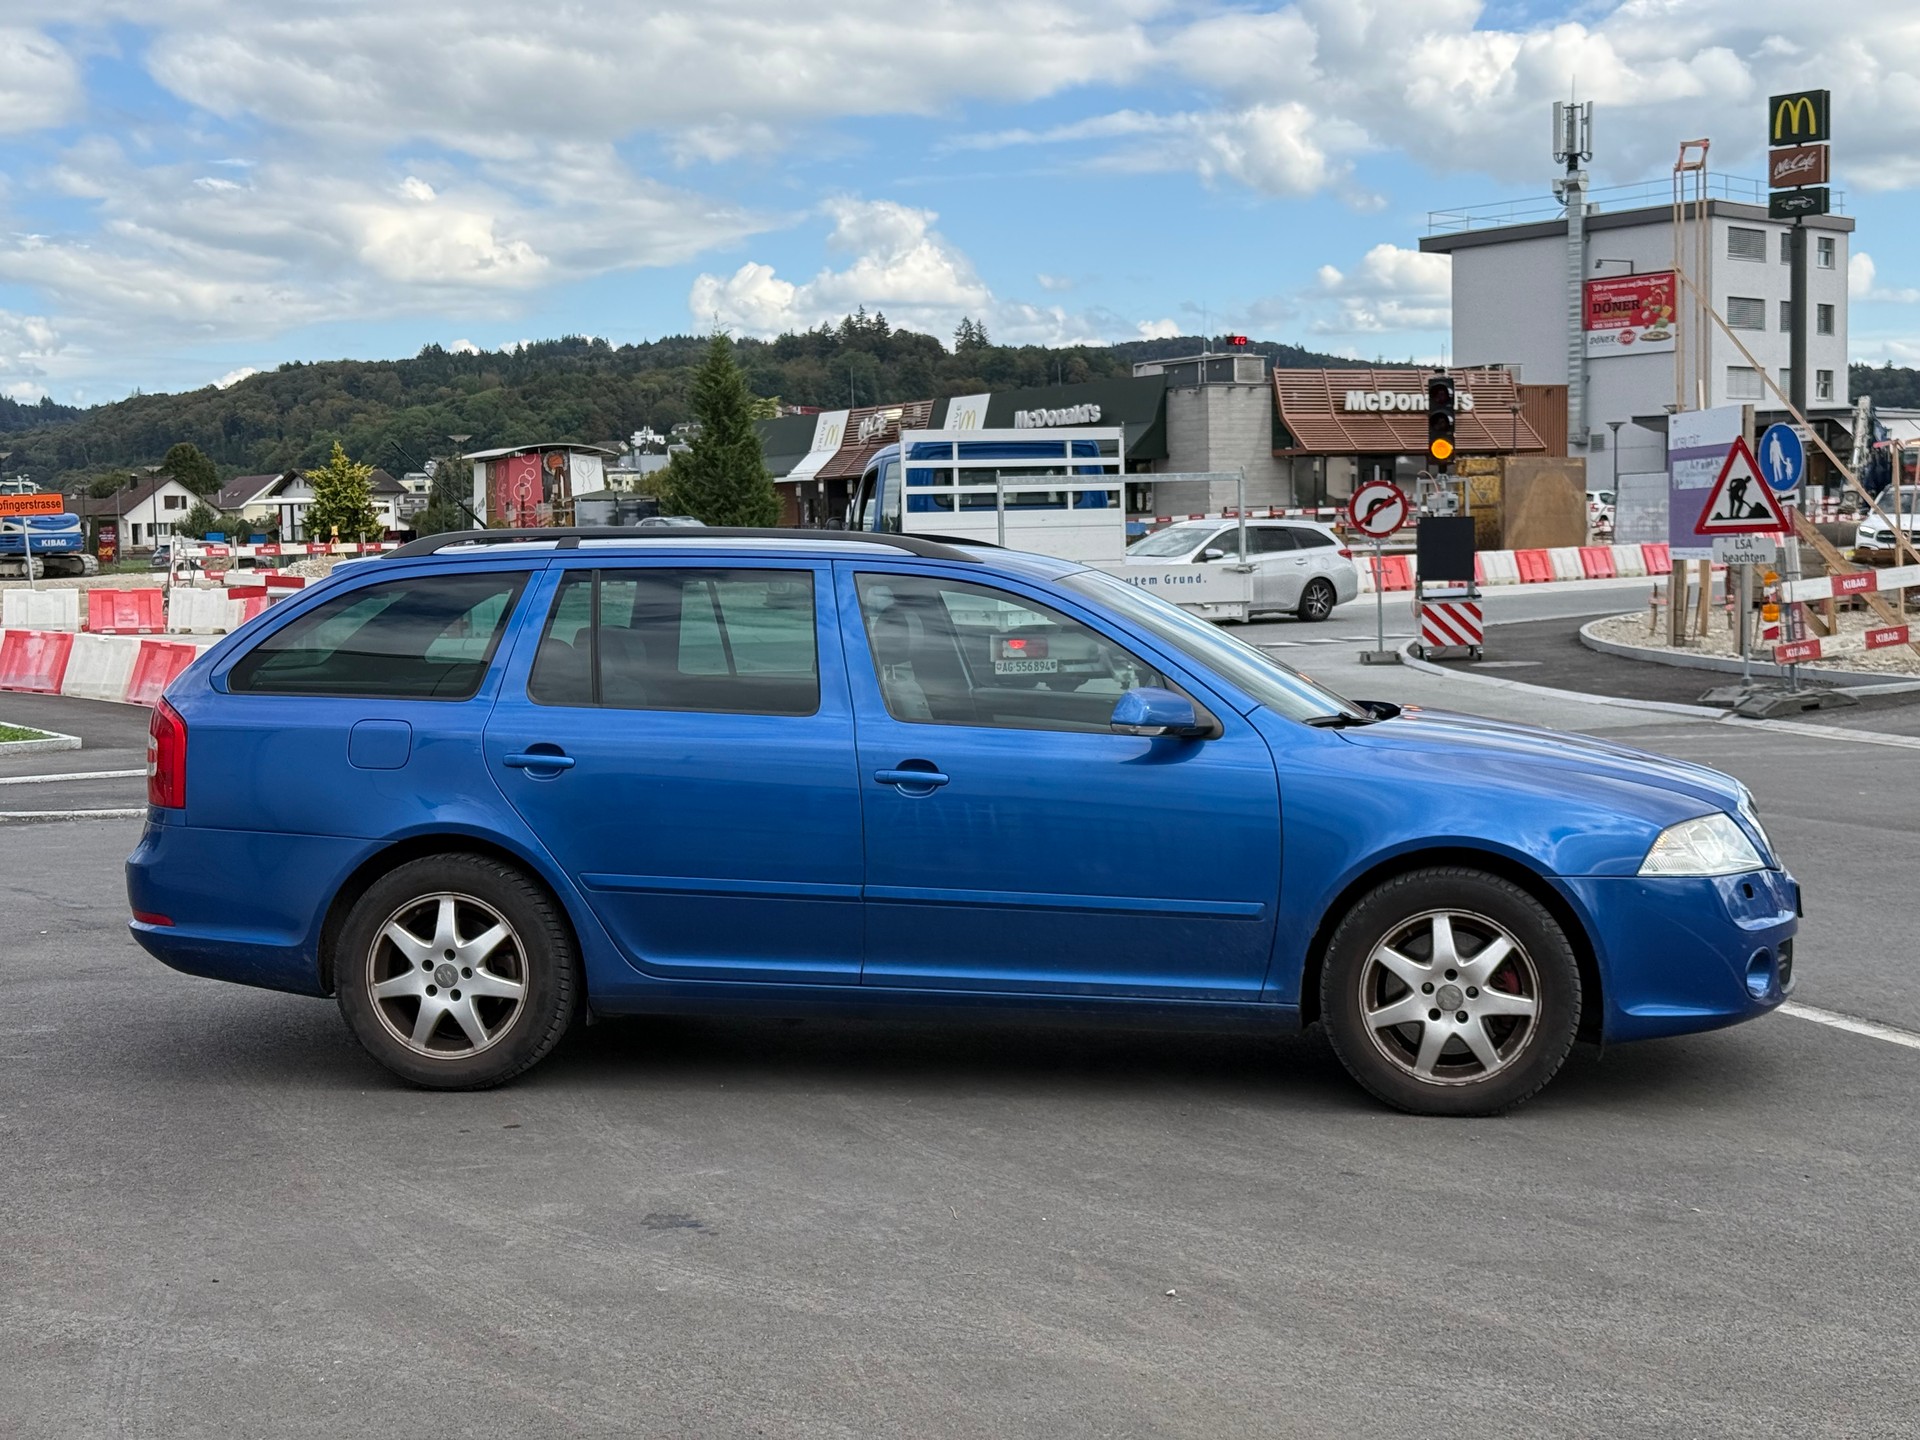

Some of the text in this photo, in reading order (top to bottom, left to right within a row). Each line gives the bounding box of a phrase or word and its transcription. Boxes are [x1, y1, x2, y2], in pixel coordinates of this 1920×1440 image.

[1592, 299, 1641, 314] DÖNER
[1344, 390, 1474, 411] McDon's
[1014, 403, 1101, 429] McDonald's
[41, 539, 67, 547] KIBAG
[1735, 538, 1753, 549] LSA
[1722, 551, 1766, 563] beachten
[1164, 573, 1207, 585] Grund.
[1842, 577, 1868, 590] KIBAG
[1875, 631, 1899, 644] KIBAG
